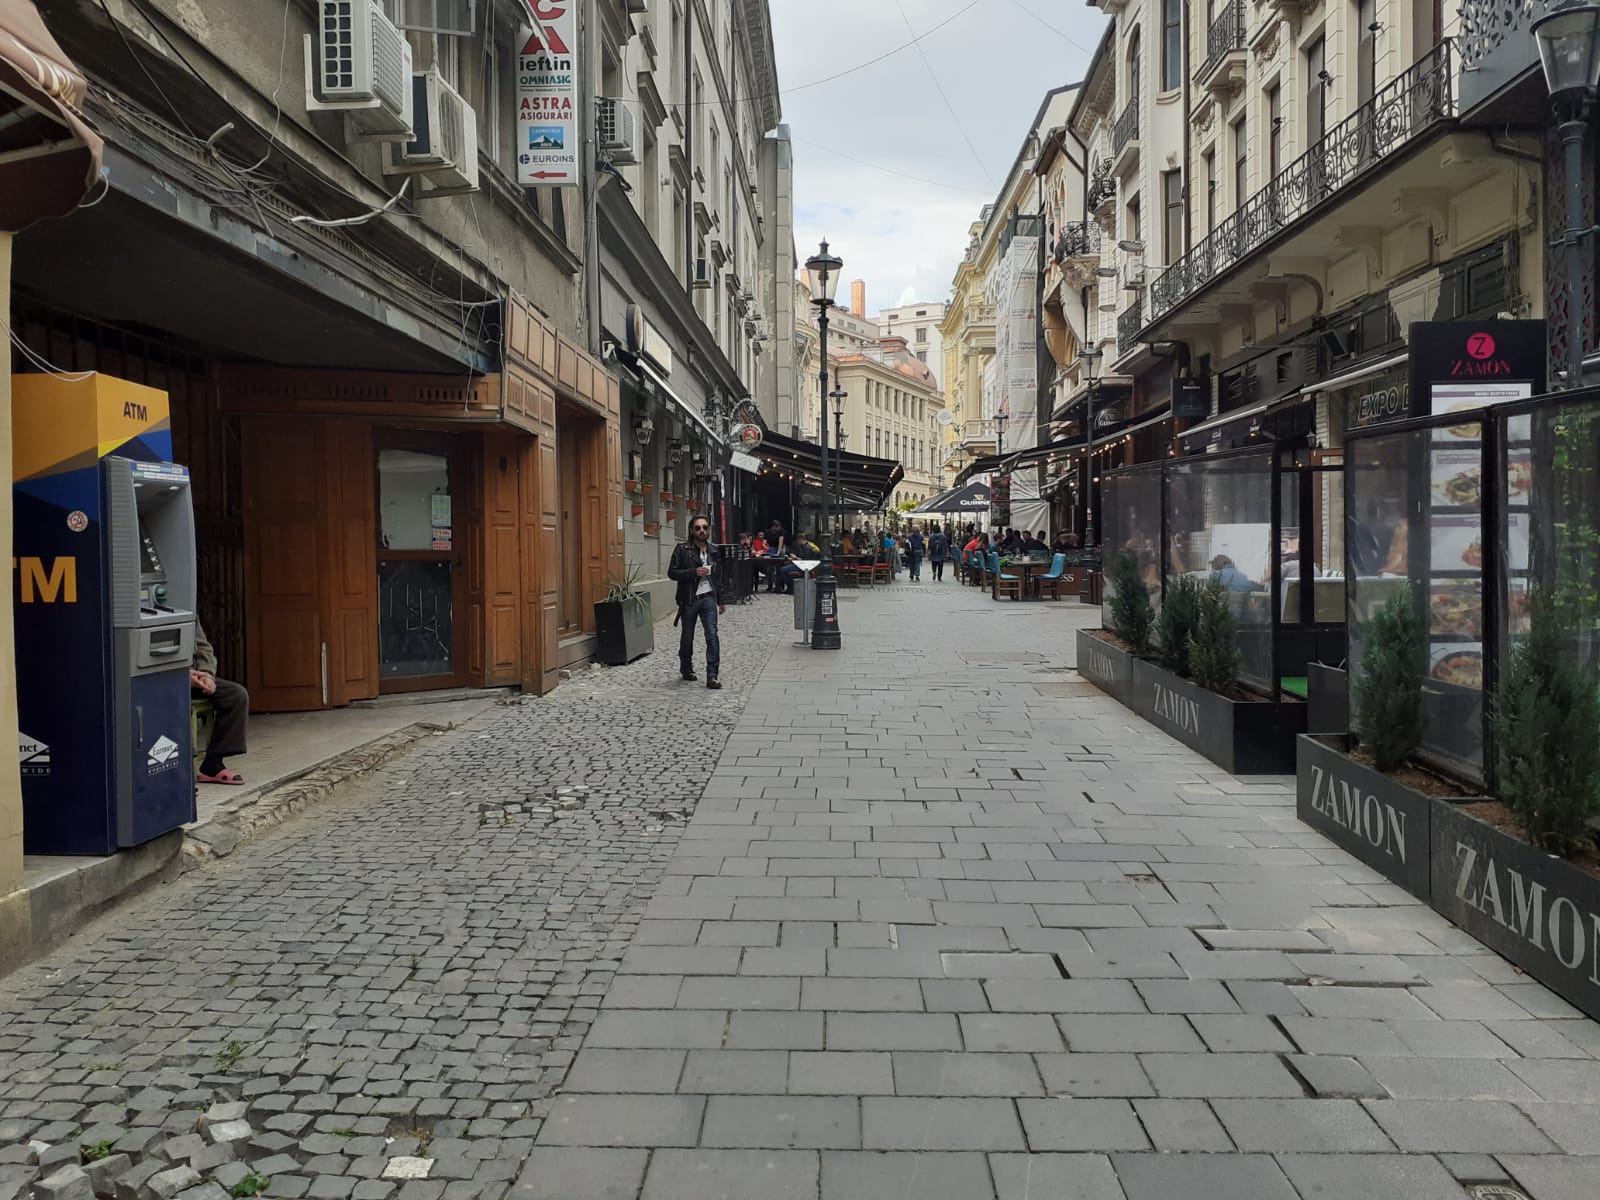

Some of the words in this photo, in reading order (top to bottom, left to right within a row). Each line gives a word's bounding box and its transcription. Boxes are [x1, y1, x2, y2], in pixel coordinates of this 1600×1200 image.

[519, 56, 571, 71] ieftin
[520, 75, 571, 85] OMNIASIG
[520, 97, 572, 110] ASTRA
[520, 110, 573, 120] ASIGURĂRI
[532, 154, 575, 163] EUROINS
[1473, 337, 1486, 355] Z
[1451, 360, 1511, 375] ZAMON
[123, 401, 148, 422] ATM
[1357, 386, 1399, 421] EXPO
[13, 556, 77, 603] M
[1153, 682, 1200, 736] ZAMON
[1311, 764, 1407, 864] ZAMON
